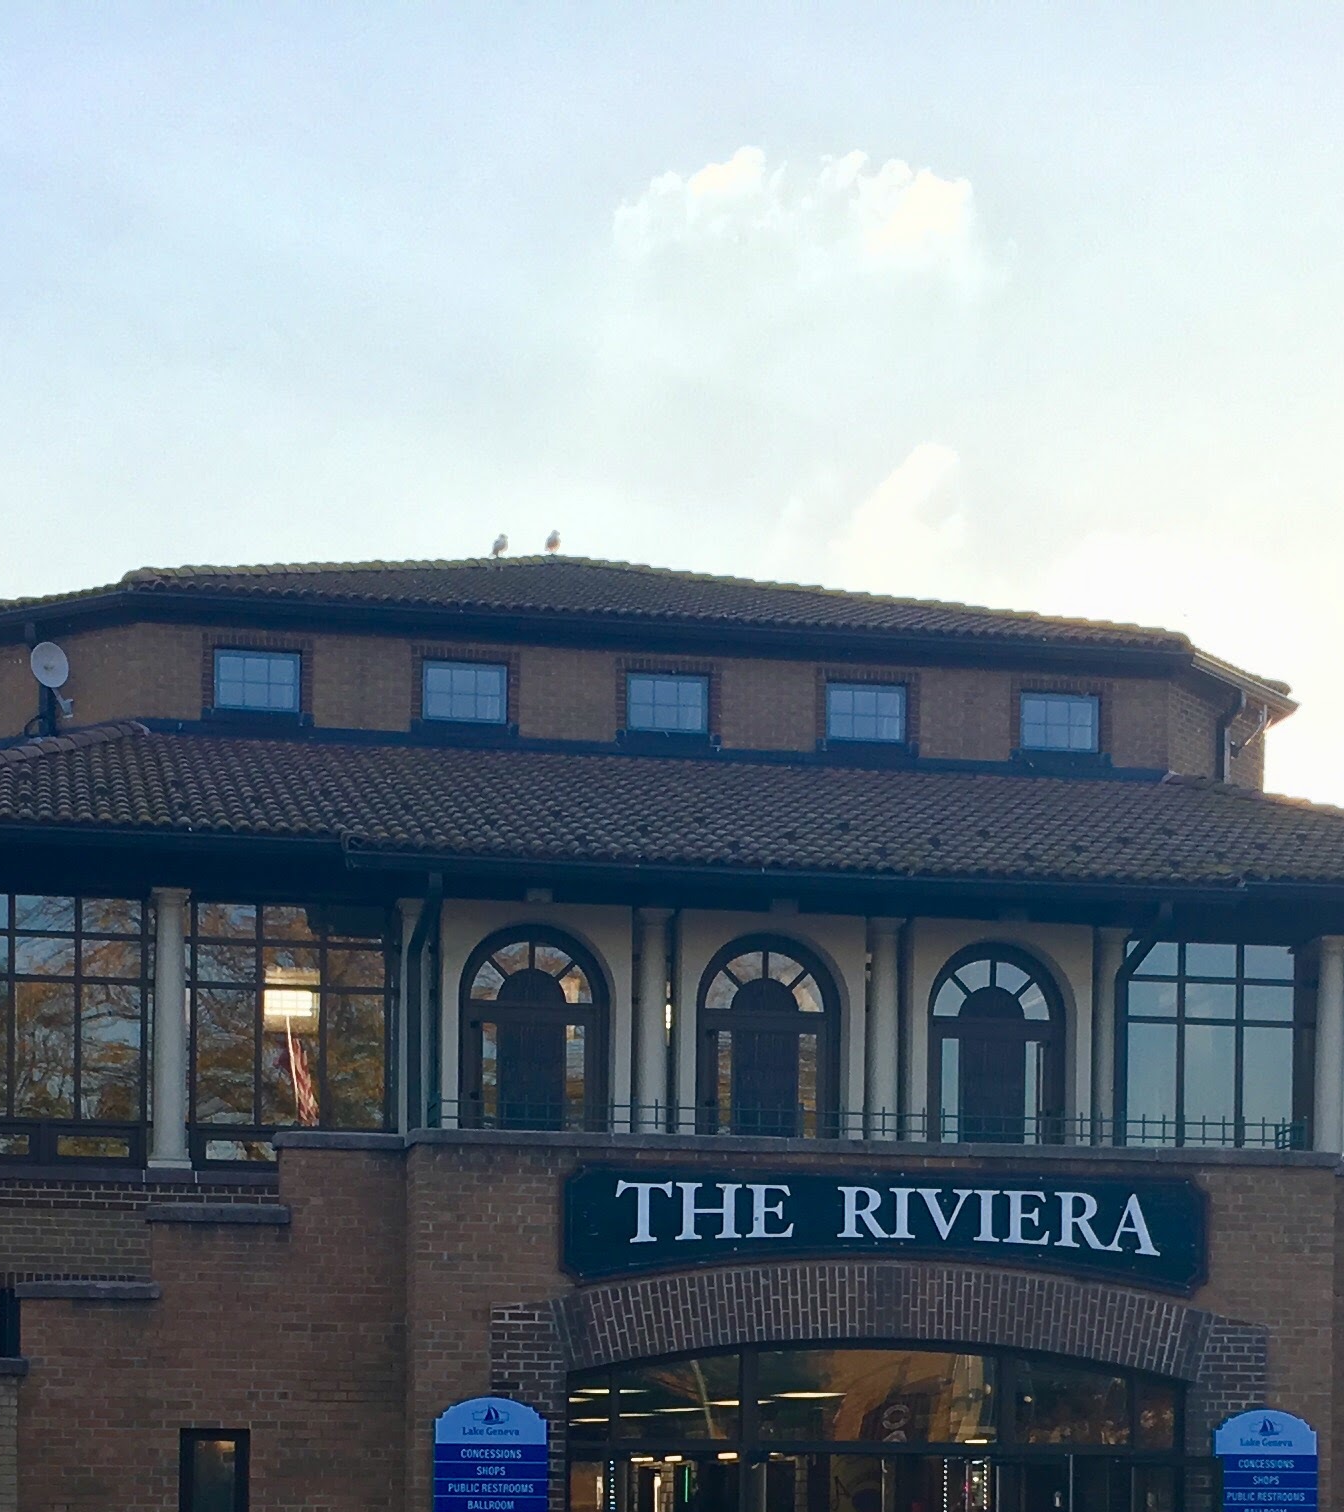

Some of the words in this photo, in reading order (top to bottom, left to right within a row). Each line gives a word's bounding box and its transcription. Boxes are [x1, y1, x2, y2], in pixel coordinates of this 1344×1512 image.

[615, 1179, 794, 1243] THE
[837, 1186, 1160, 1257] RIVIERA
[462, 1427, 484, 1436] Lake
[486, 1428, 520, 1436] Geneva
[461, 1449, 522, 1459] CONCESSIONS
[1238, 1459, 1295, 1469] CONCESSIONS
[476, 1466, 506, 1476] SHOPS
[1253, 1476, 1280, 1485] SHOPS
[448, 1483, 479, 1493] PUBLIC
[482, 1484, 534, 1493] RESTROOMS
[1227, 1492, 1255, 1501] PUBLIC
[1257, 1492, 1305, 1502] RESTROOMS
[467, 1500, 514, 1510] BALLROOM
